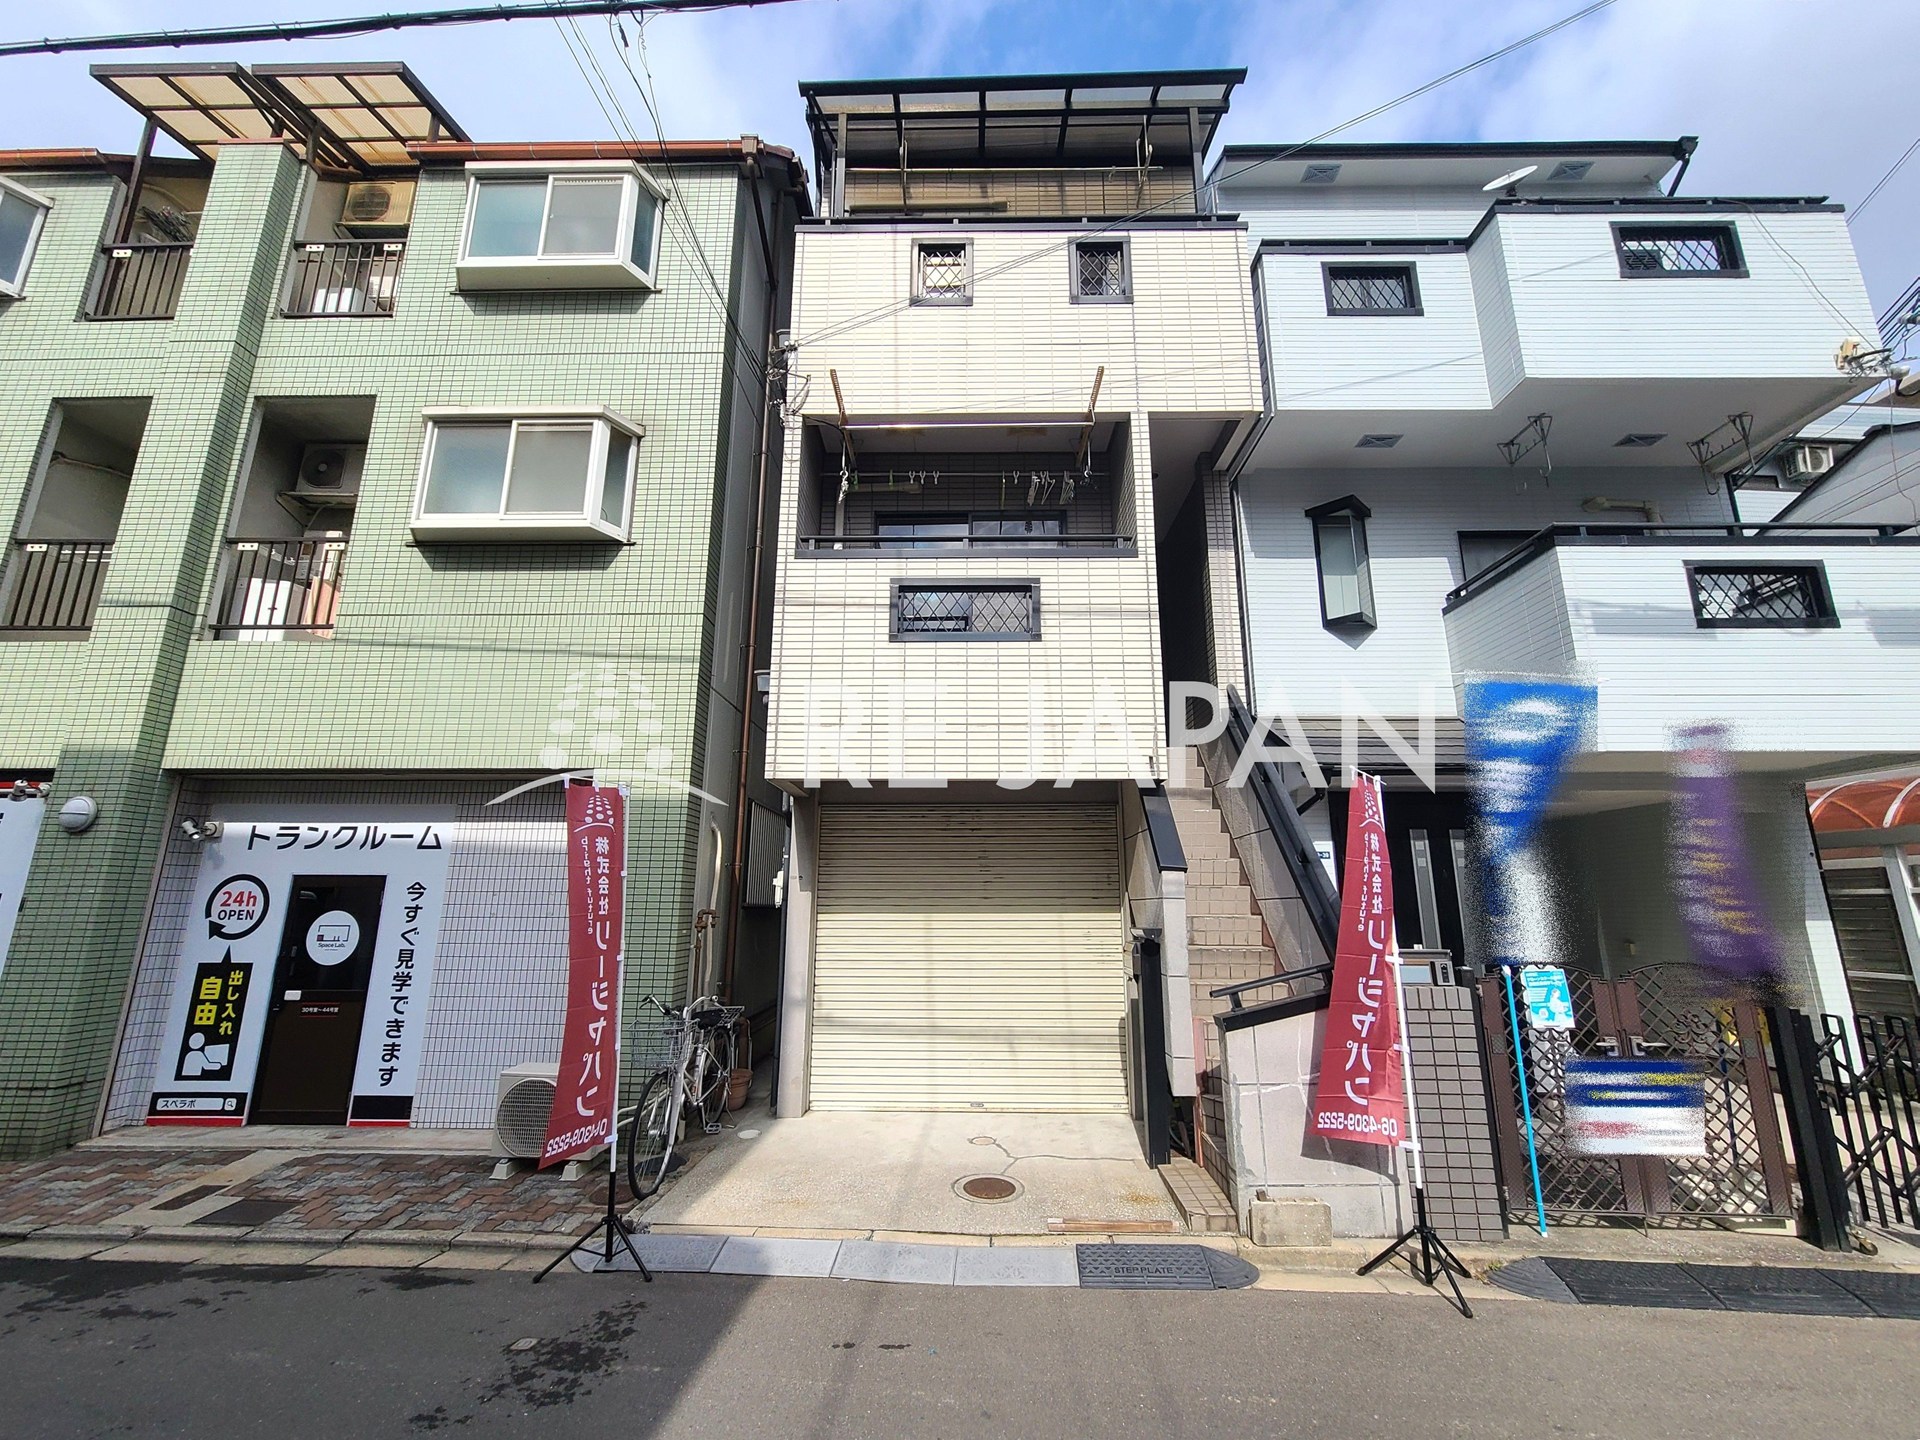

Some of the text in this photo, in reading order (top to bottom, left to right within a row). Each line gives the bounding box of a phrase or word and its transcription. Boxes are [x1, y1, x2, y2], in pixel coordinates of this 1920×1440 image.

[248, 825, 442, 850] トランクルーム
[220, 891, 258, 907] 24h
[217, 909, 255, 920] OPEN
[379, 881, 427, 1087] 今すぐ見学できます
[193, 976, 222, 1025] 自由
[219, 970, 244, 1035] 出し入れ
[1114, 1266, 1174, 1274] STEP PLATE
